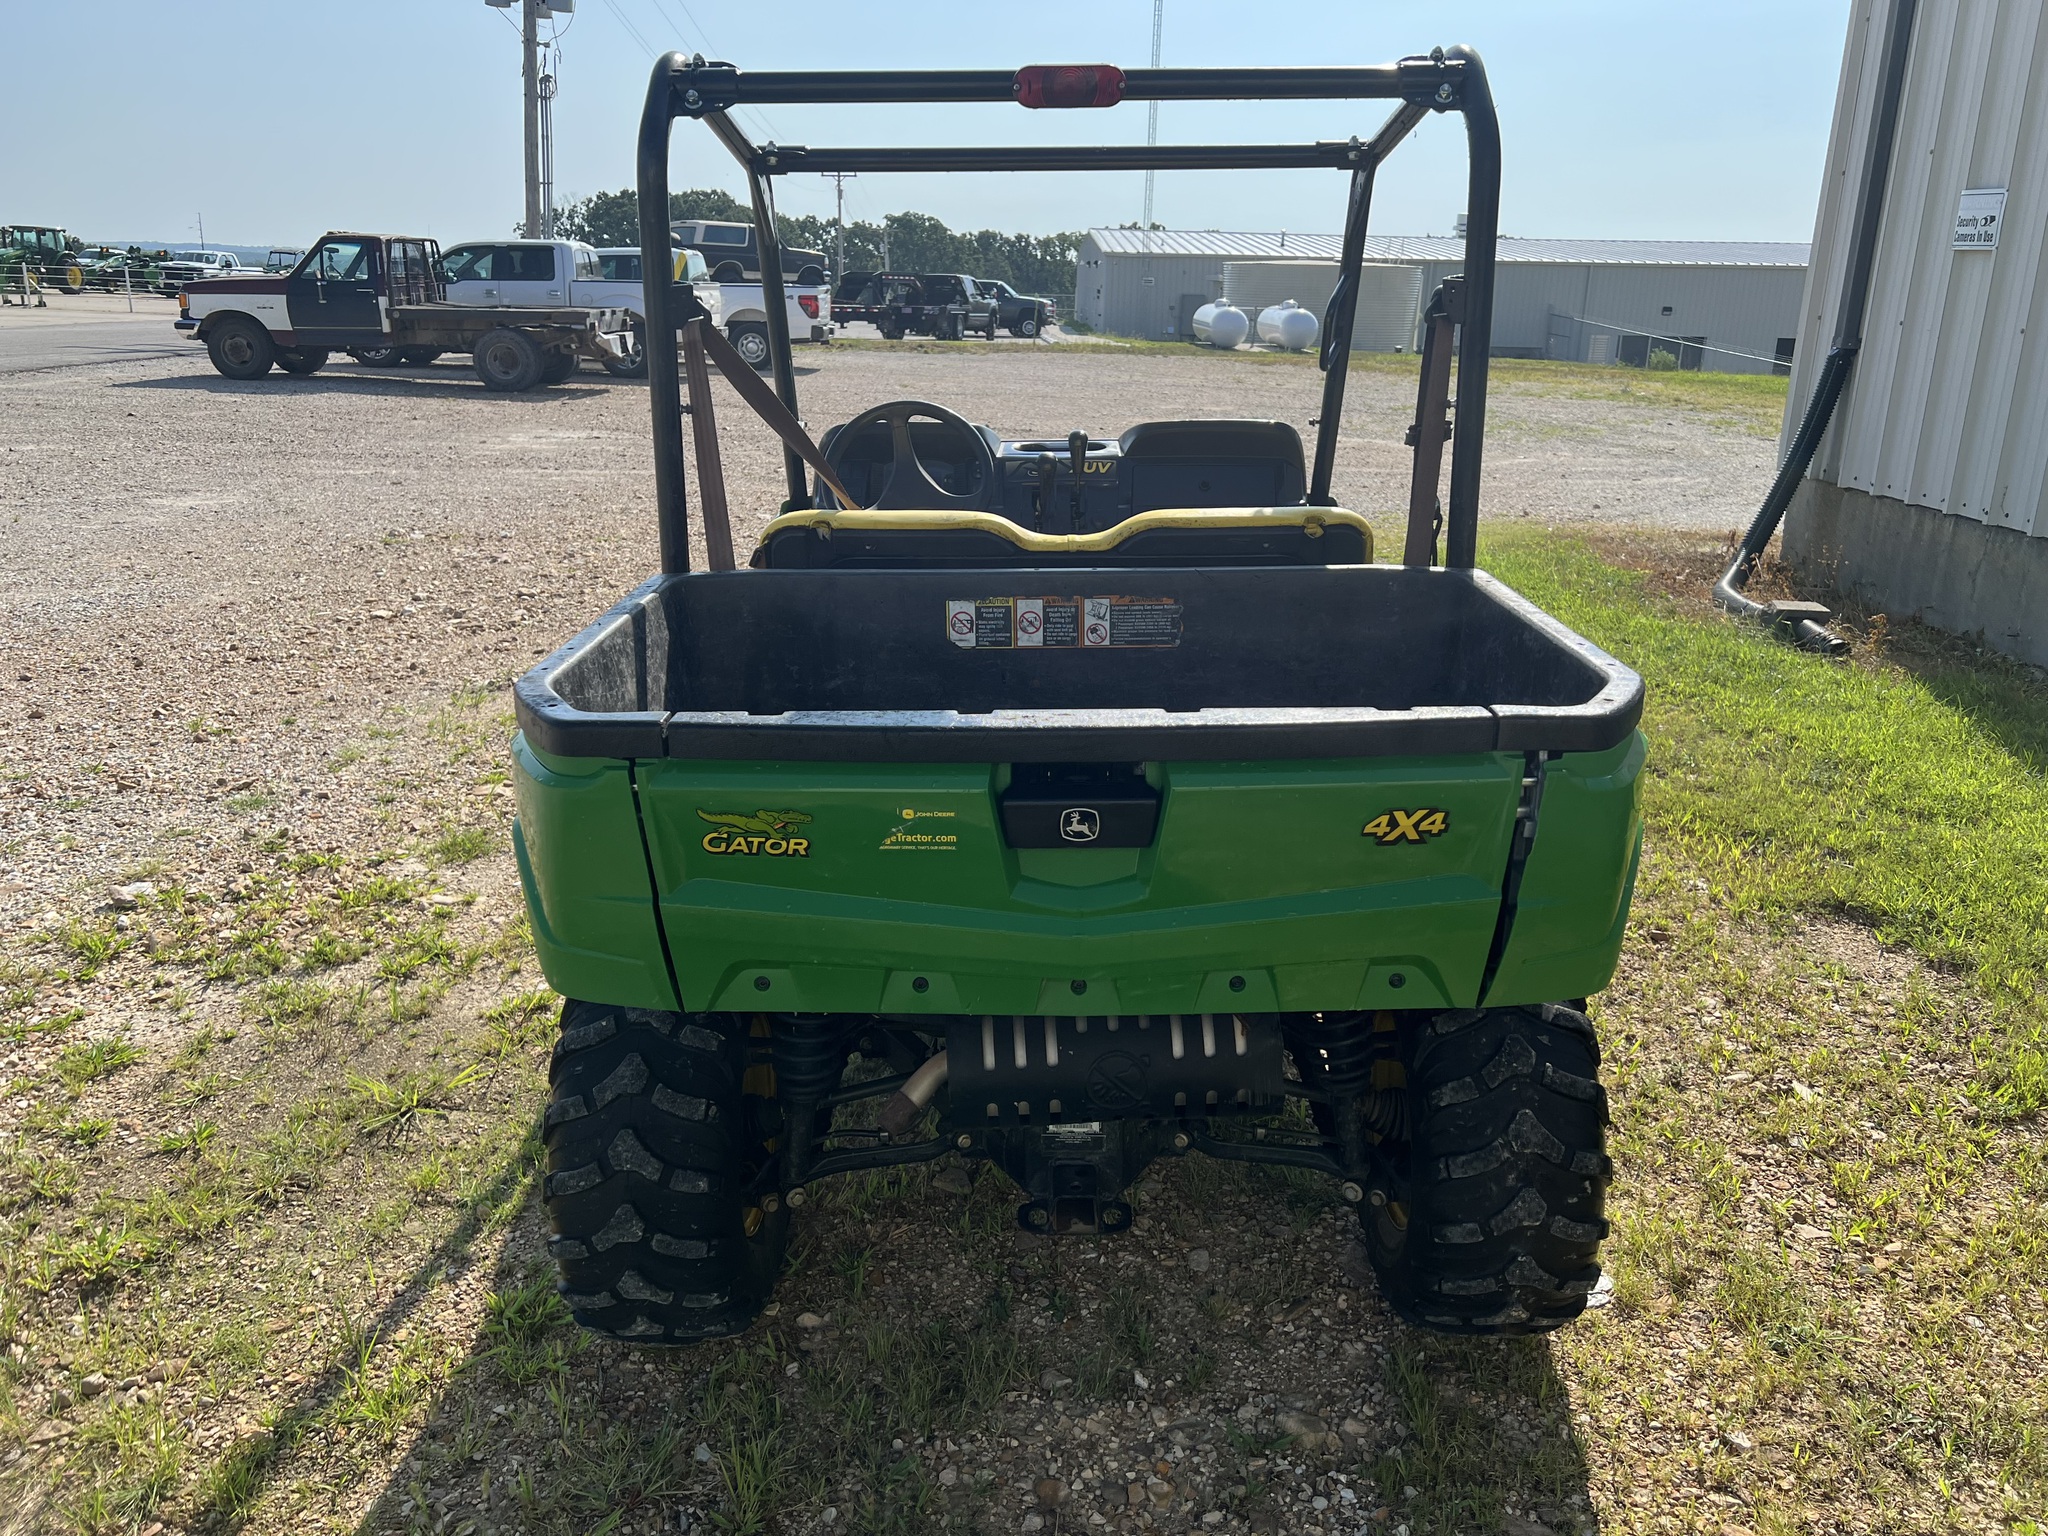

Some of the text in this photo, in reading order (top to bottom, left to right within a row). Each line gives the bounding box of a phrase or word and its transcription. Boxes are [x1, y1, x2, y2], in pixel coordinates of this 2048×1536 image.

[1957, 215, 1979, 229] Security
[1954, 230, 1976, 242] Cameras
[1983, 230, 1994, 242] Use
[1069, 461, 1114, 474] UV
[1362, 808, 1448, 843] 4X4
[702, 832, 809, 857] GATOR
[882, 833, 957, 844] geTractor.com
